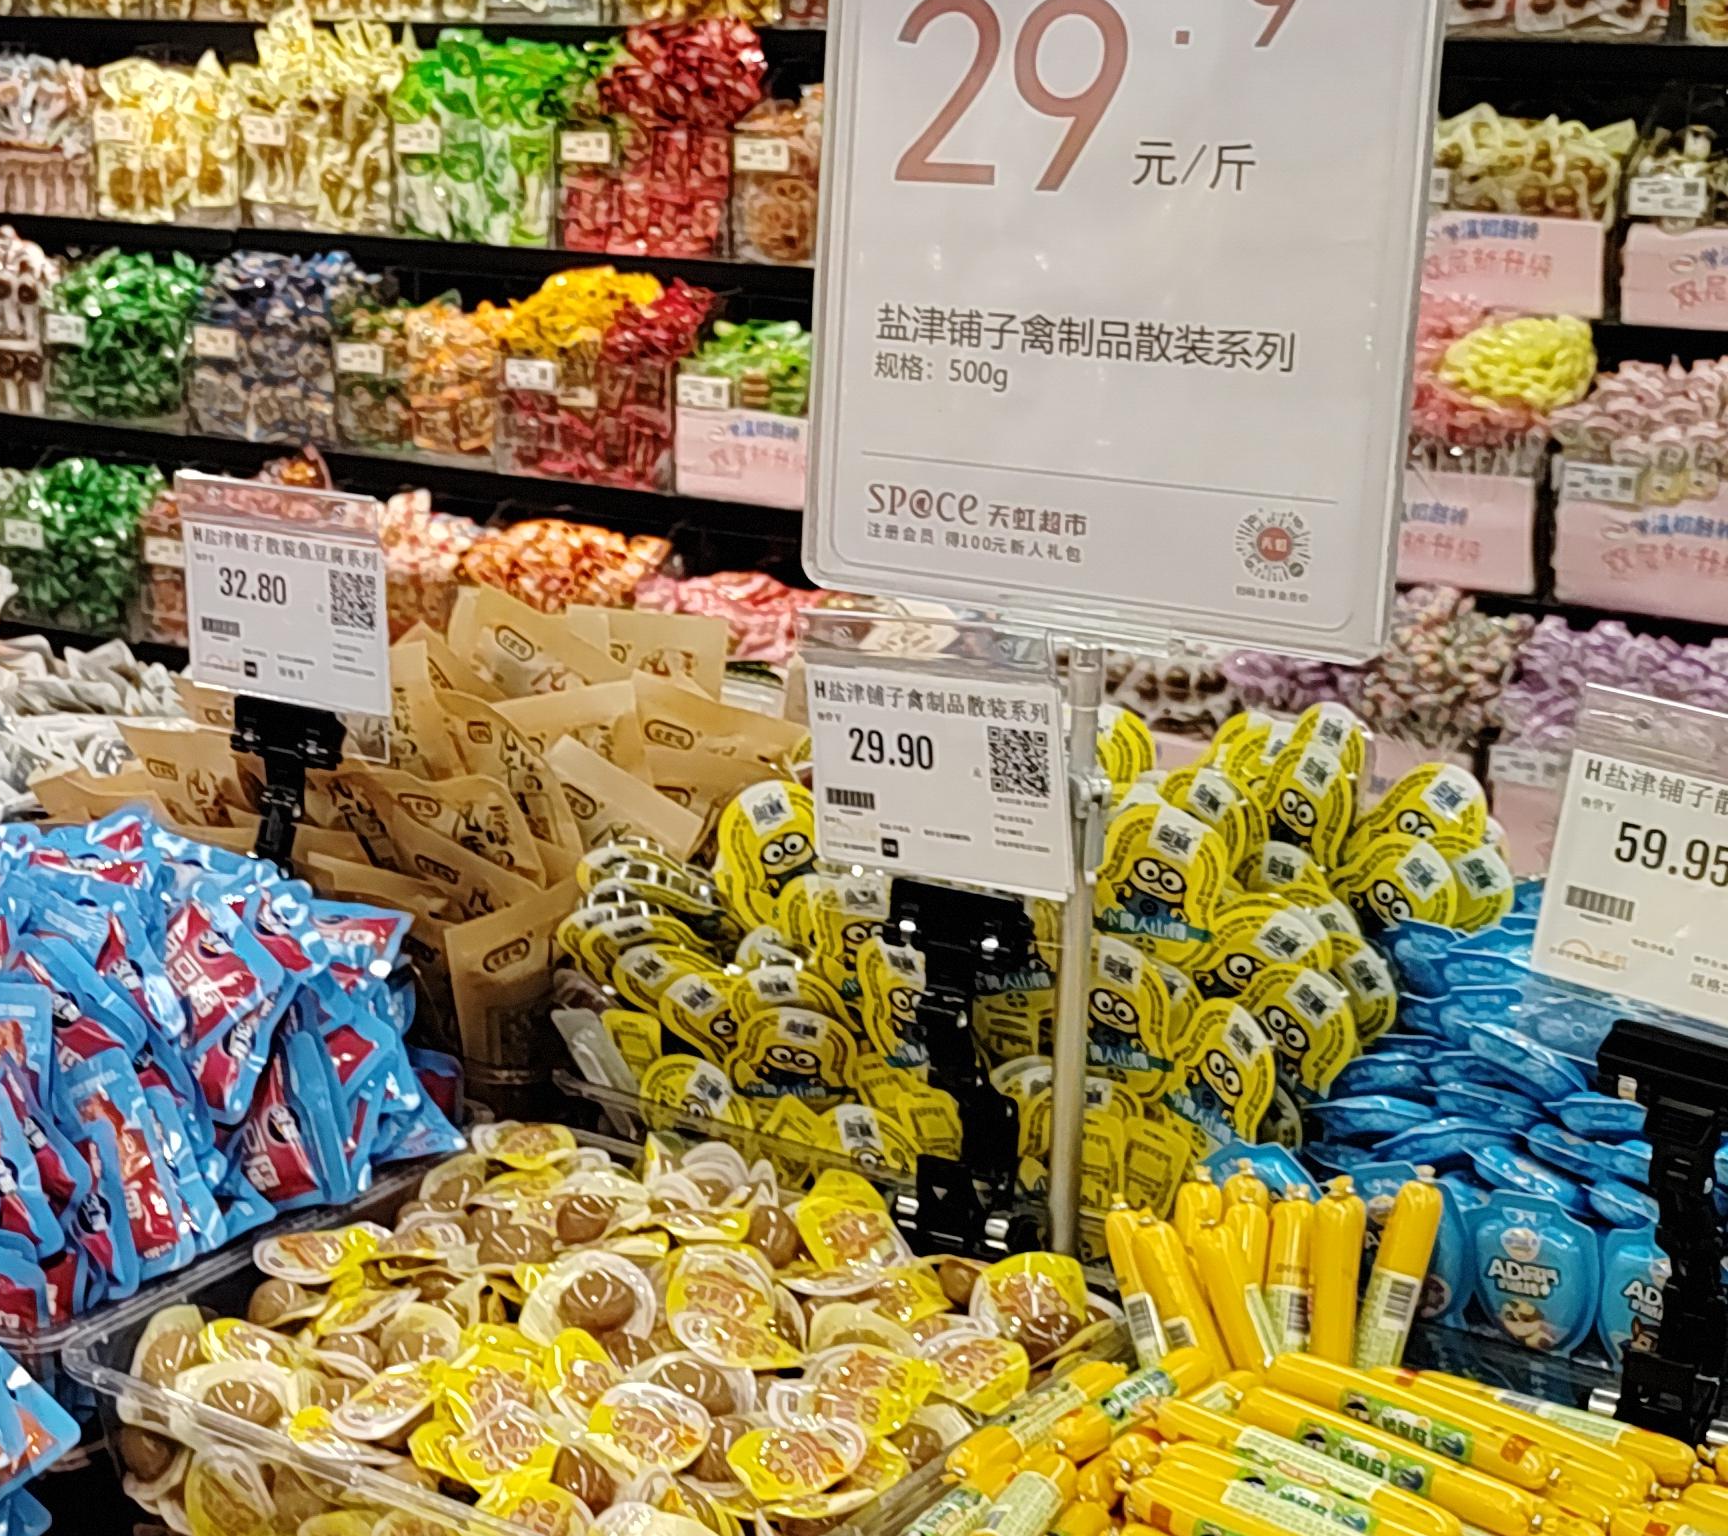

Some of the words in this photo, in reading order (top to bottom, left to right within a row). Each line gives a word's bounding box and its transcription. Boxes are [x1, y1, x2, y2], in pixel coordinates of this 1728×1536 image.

[876, 303, 1295, 373] 盐津铺子禽制品散装系列
[986, 504, 1087, 538] 天虹超市
[218, 566, 287, 605] 32.80
[848, 727, 934, 771] 29.90
[1614, 821, 1728, 887] 59.95
